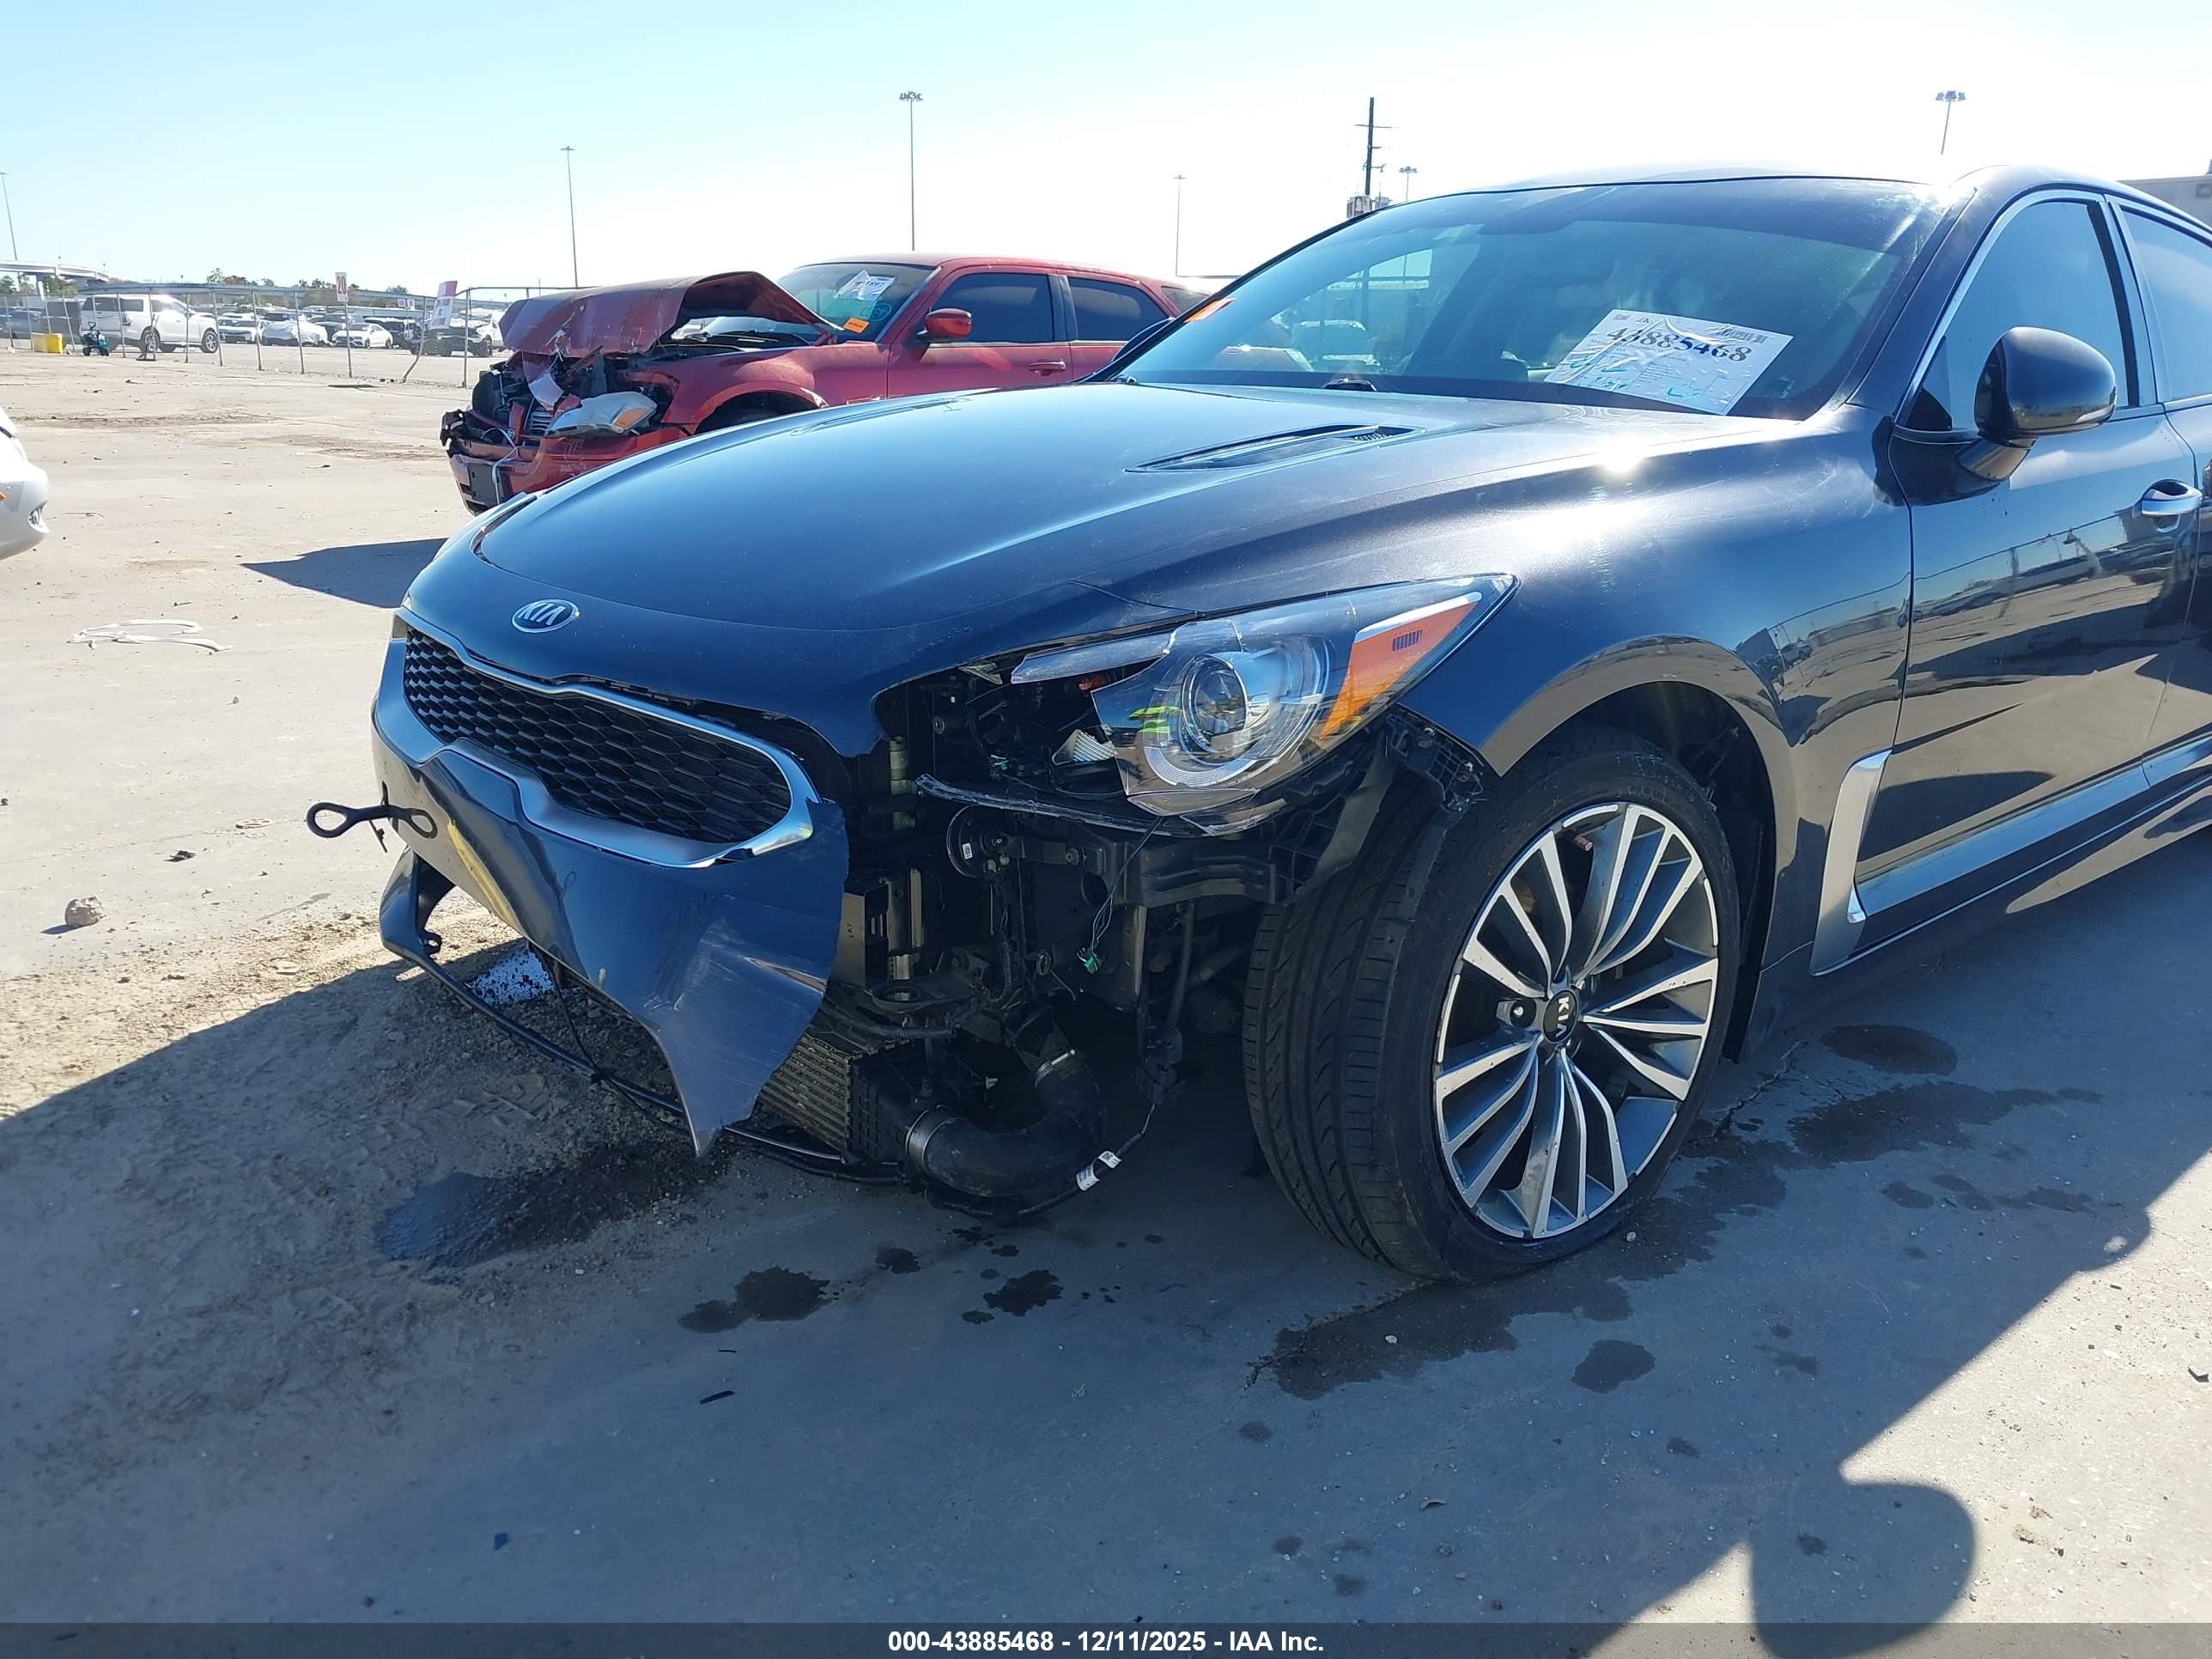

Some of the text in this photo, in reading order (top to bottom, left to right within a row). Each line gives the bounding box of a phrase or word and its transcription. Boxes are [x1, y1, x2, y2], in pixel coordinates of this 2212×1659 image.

[337, 276, 346, 295] 20
[1607, 327, 1753, 362] 43885468
[516, 601, 567, 626] KIA
[1555, 996, 1570, 1038] KIA
